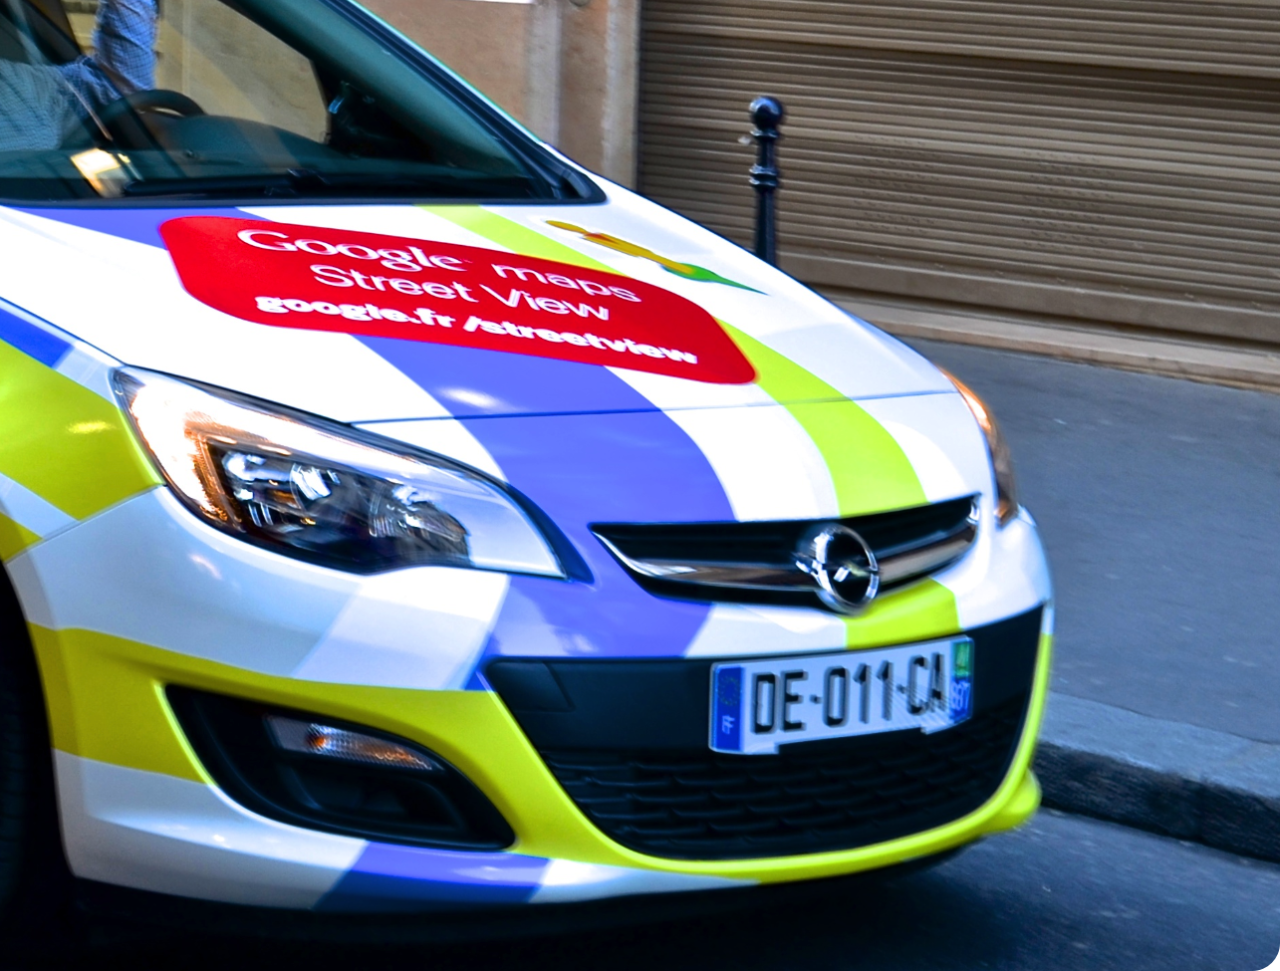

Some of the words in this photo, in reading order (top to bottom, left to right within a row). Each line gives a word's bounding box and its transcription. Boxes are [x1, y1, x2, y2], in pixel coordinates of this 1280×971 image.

[236, 229, 468, 272] Google
[491, 261, 642, 303] maps
[310, 264, 479, 303] Street
[479, 282, 610, 321] View
[254, 295, 455, 328] google.fr
[464, 315, 697, 364] /streetview
